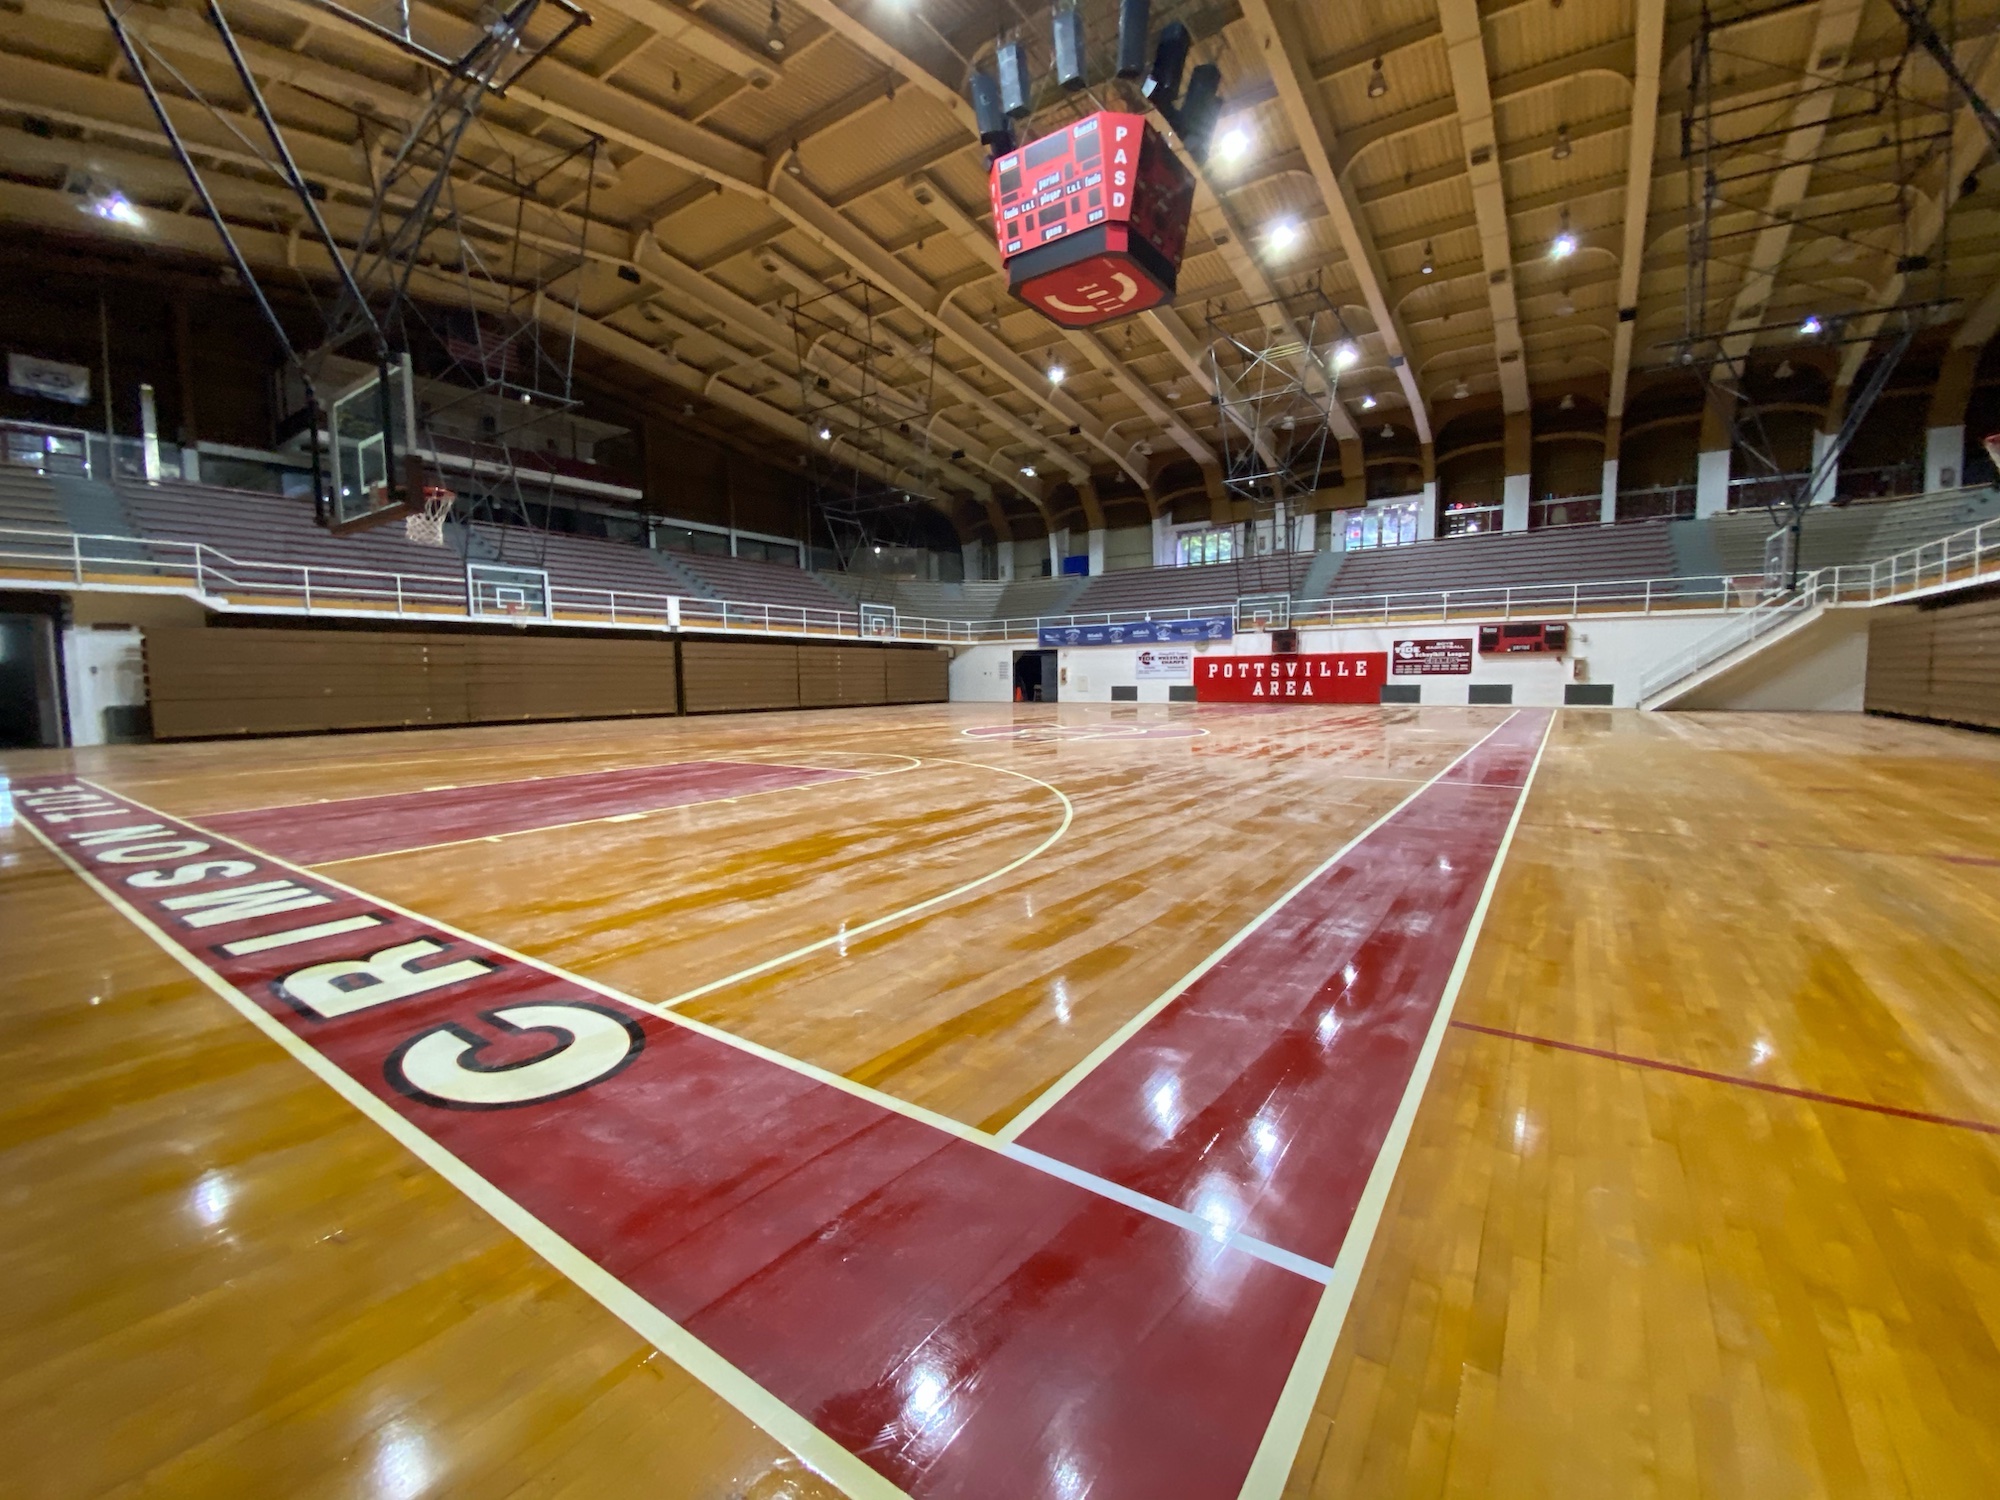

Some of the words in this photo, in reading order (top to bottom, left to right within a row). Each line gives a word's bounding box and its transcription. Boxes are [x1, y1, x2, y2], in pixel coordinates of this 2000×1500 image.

[1112, 125, 1128, 208] PASD
[1038, 172, 1060, 191] period
[1040, 189, 1062, 206] player
[1208, 660, 1367, 678] POTTSVILLE
[1252, 680, 1313, 696] AREA
[12, 784, 131, 824] TIDE
[66, 822, 642, 1109] CRIMSON
